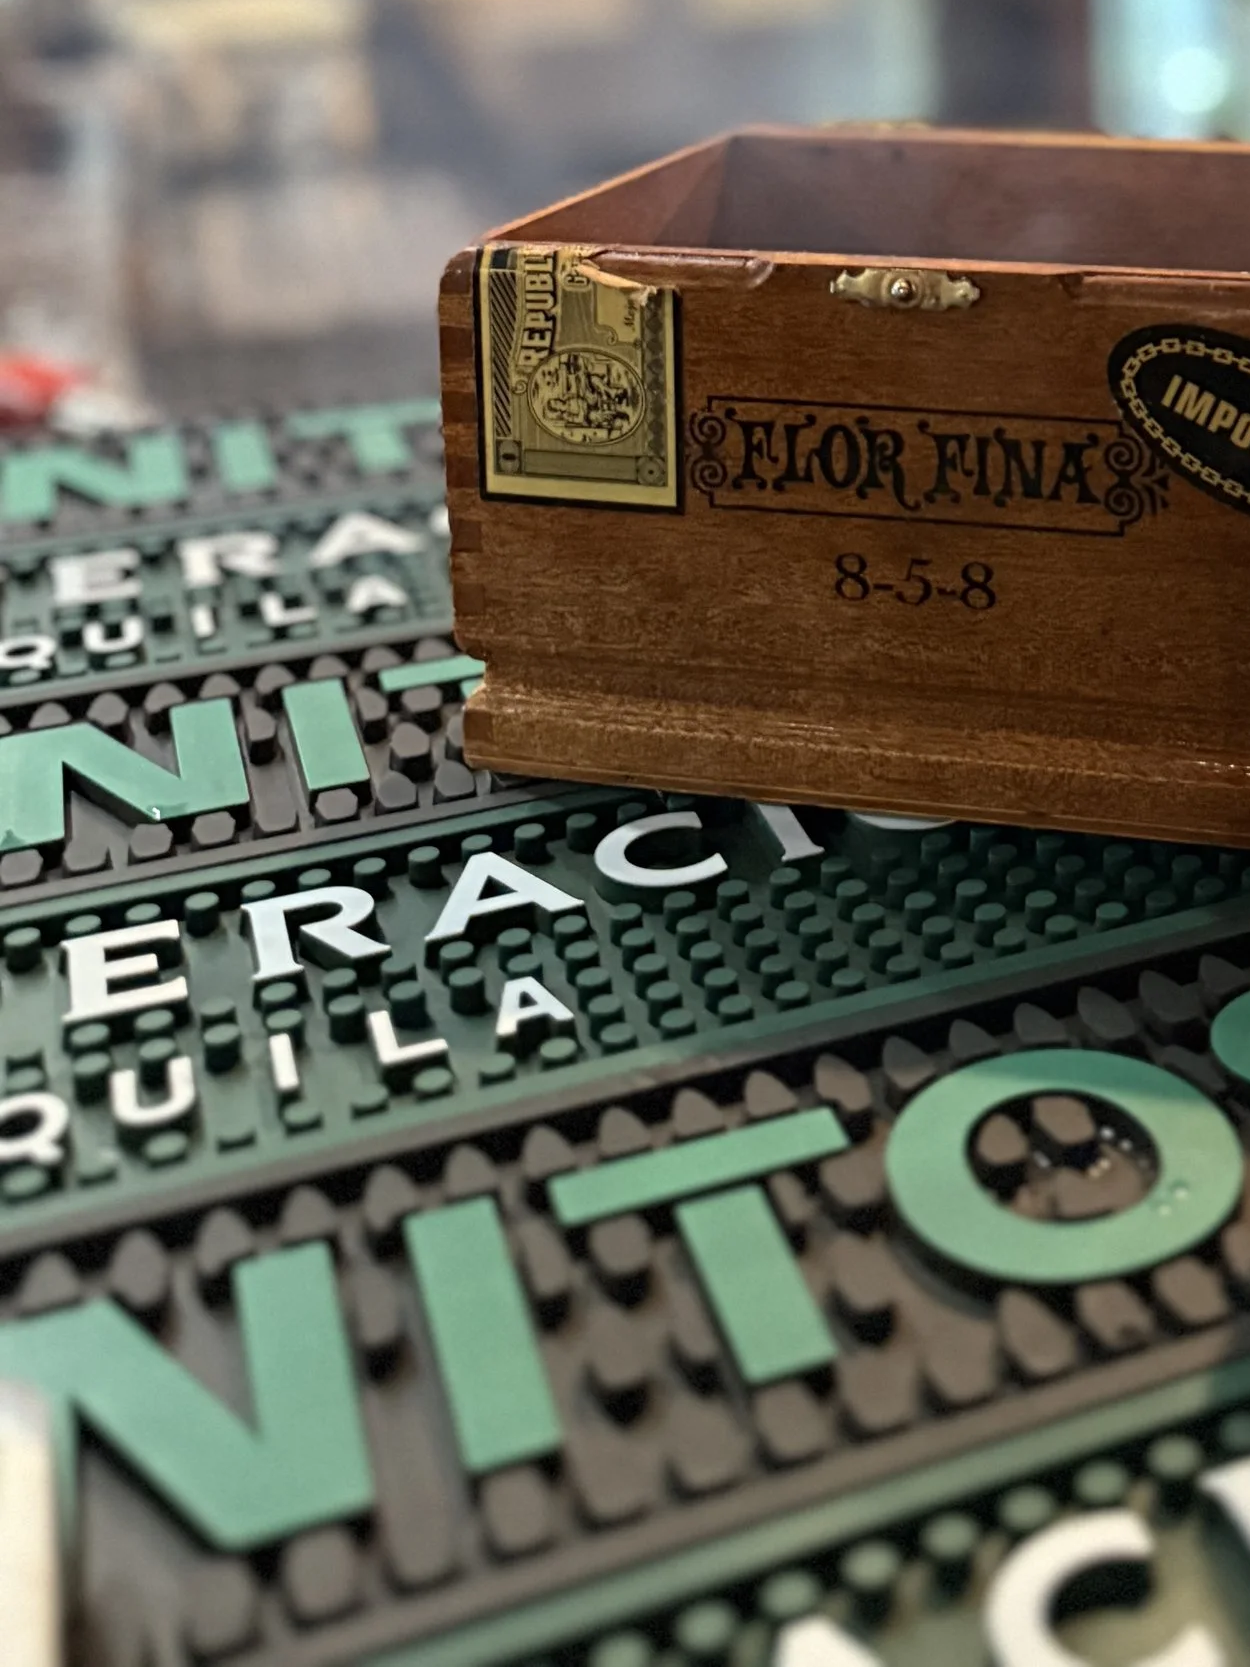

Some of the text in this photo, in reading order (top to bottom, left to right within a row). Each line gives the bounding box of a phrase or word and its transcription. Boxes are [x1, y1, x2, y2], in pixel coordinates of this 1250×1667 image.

[724, 406, 1102, 512] FLOR FINA
[48, 506, 451, 605] ERA
[833, 552, 996, 611] 8-5-8
[62, 802, 956, 1024] ERACI
[0, 976, 574, 1166] QUILA
